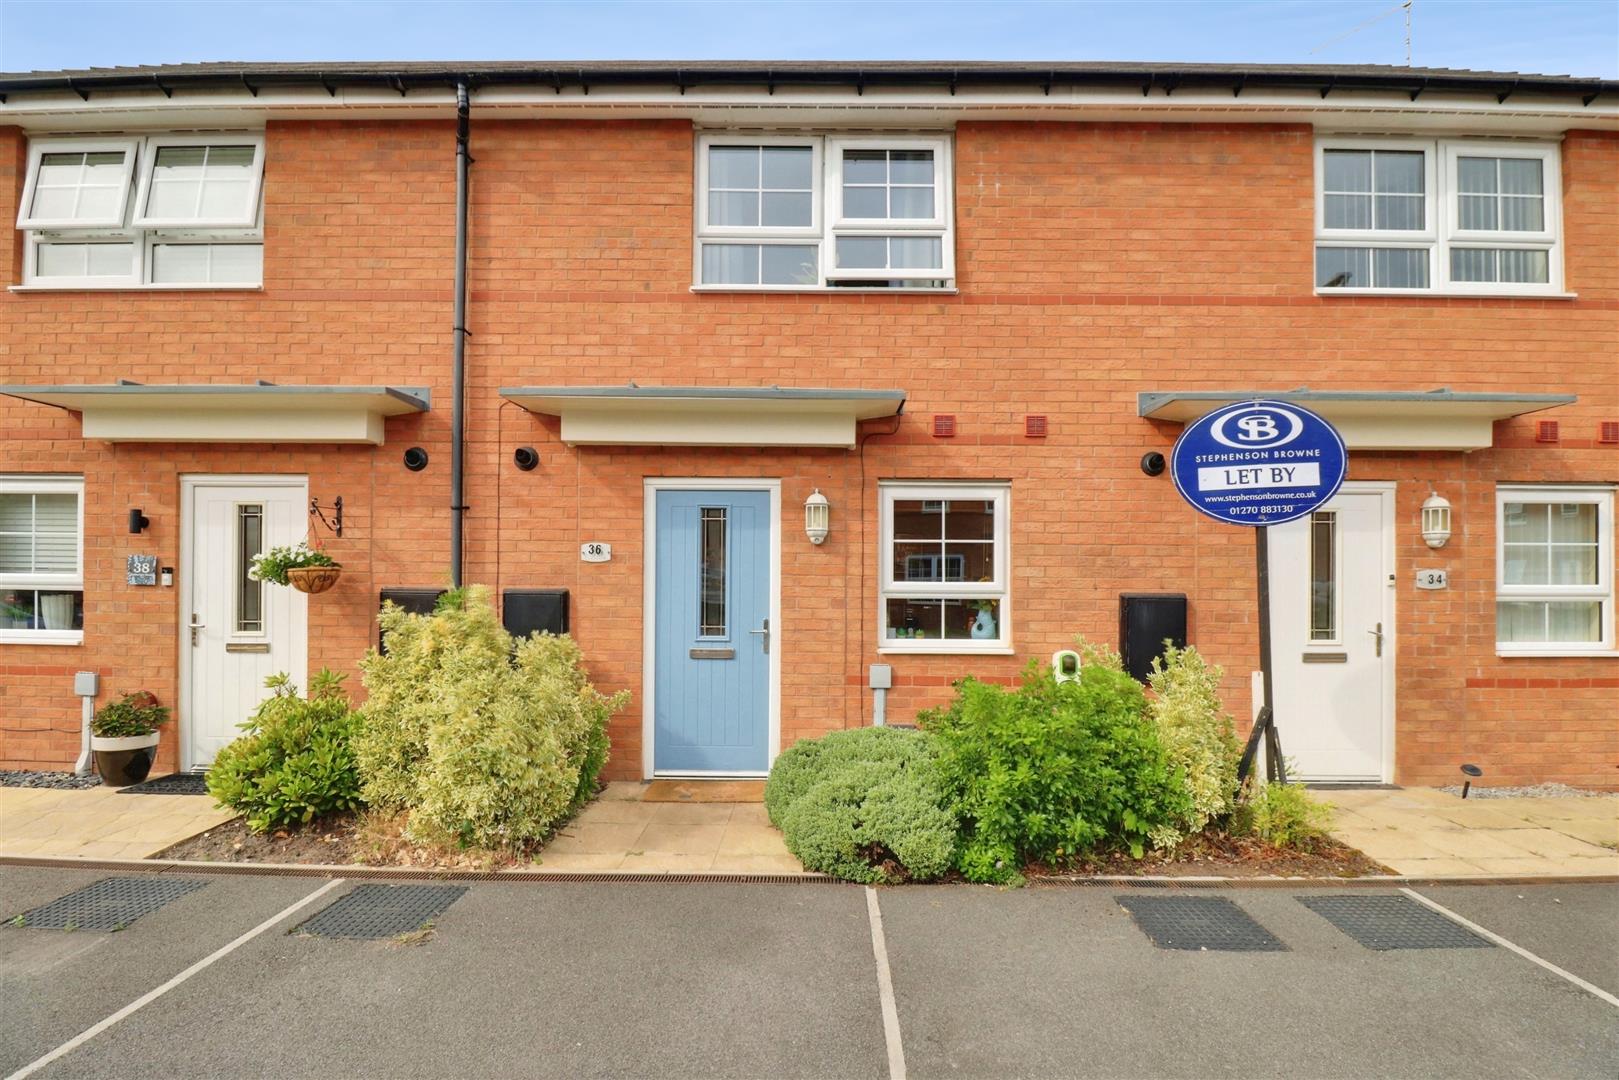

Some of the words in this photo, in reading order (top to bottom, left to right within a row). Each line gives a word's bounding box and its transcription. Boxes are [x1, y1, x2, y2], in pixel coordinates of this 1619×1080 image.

[1195, 451, 1269, 463] STEPHENSON
[1274, 449, 1321, 458] BROWNE
[1224, 468, 1262, 486] LET
[1269, 467, 1296, 483] BY
[1204, 490, 1317, 503] www.stephensonbrowne.co.uk
[1229, 505, 1258, 515] 01270
[1260, 504, 1294, 514] 883130
[588, 544, 602, 555] 36
[133, 562, 150, 574] 38
[1428, 574, 1442, 585] 34
